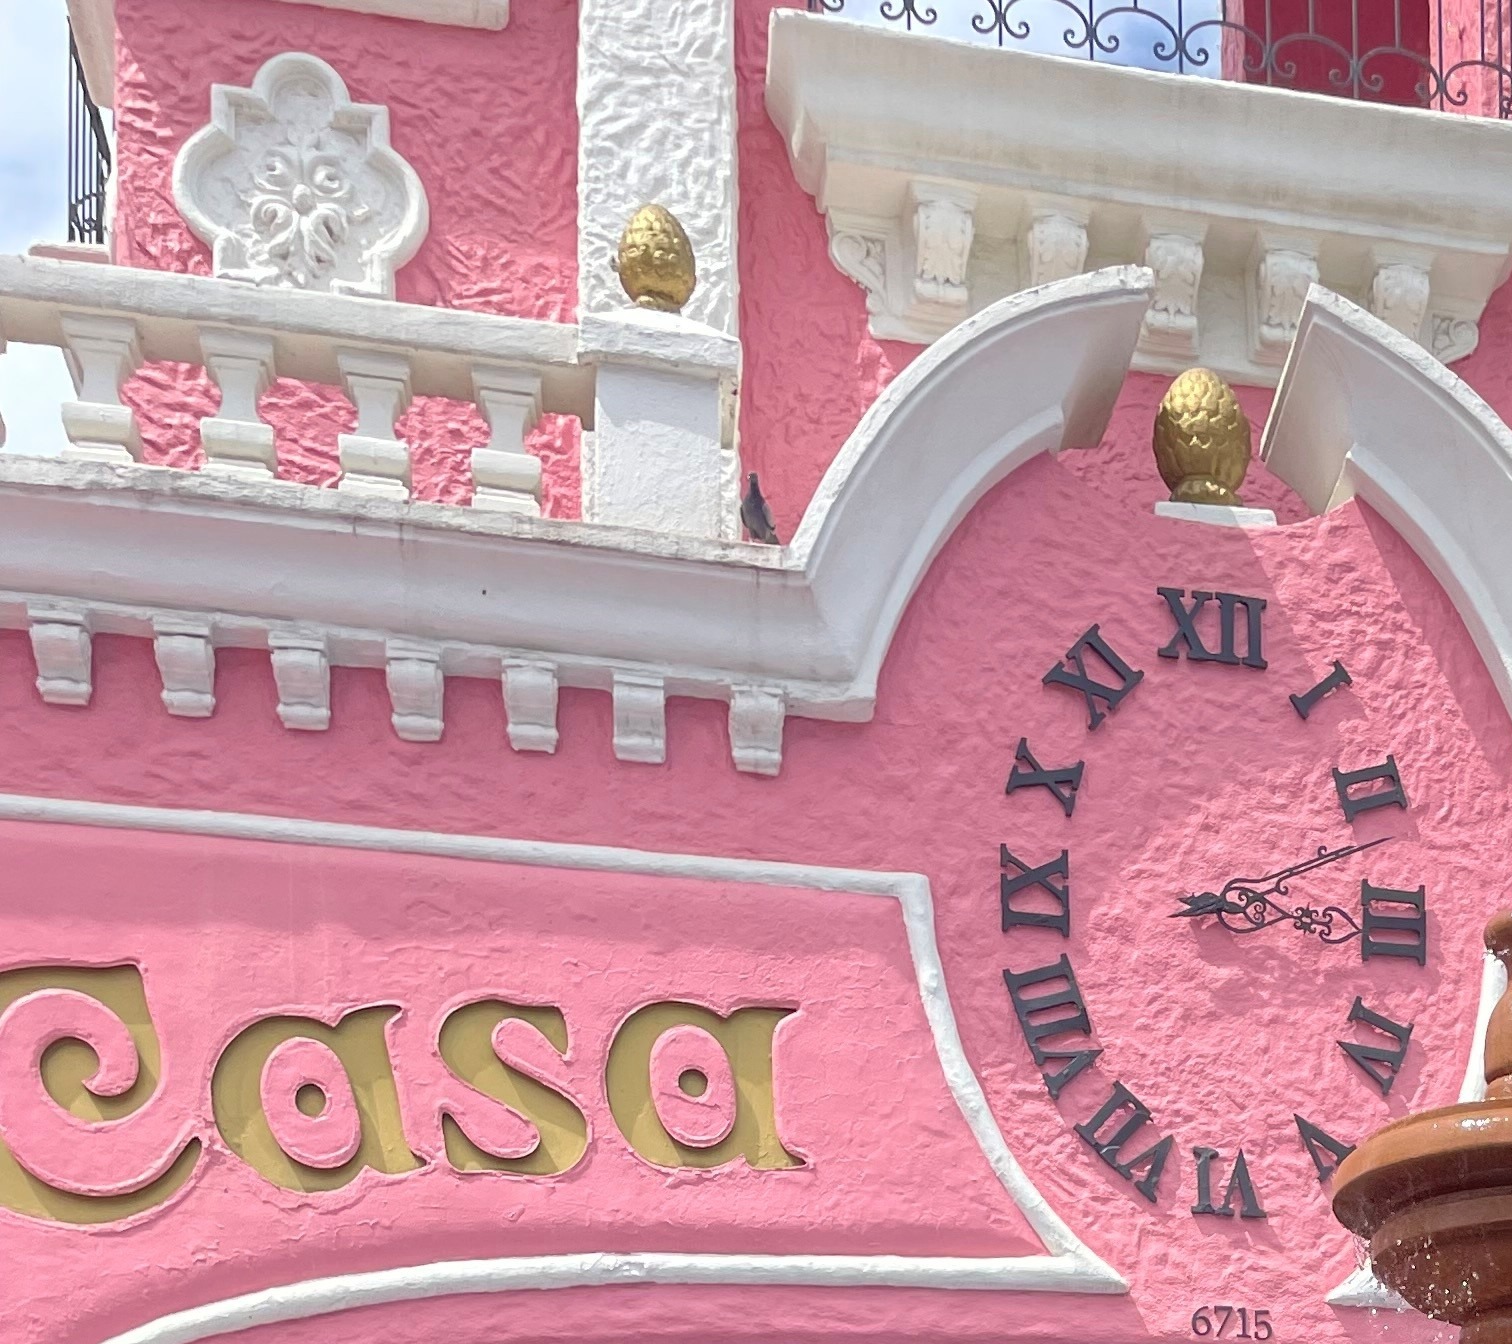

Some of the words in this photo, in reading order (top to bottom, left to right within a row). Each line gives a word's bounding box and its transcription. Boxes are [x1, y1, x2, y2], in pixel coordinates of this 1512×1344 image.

[1157, 586, 1268, 670] XII
[1042, 624, 1144, 731] XI
[1289, 660, 1353, 720] I
[1006, 737, 1085, 817] X
[1332, 753, 1409, 824] II
[1000, 842, 1071, 938] IX
[1362, 877, 1427, 967] III
[1002, 952, 1103, 1100] VIII
[1337, 996, 1415, 1096] IV
[0, 960, 813, 1233] Casa
[1074, 1080, 1175, 1203] VII
[1191, 1146, 1268, 1220] VI
[1293, 1113, 1357, 1182] V
[1190, 1305, 1274, 1341] 6715
